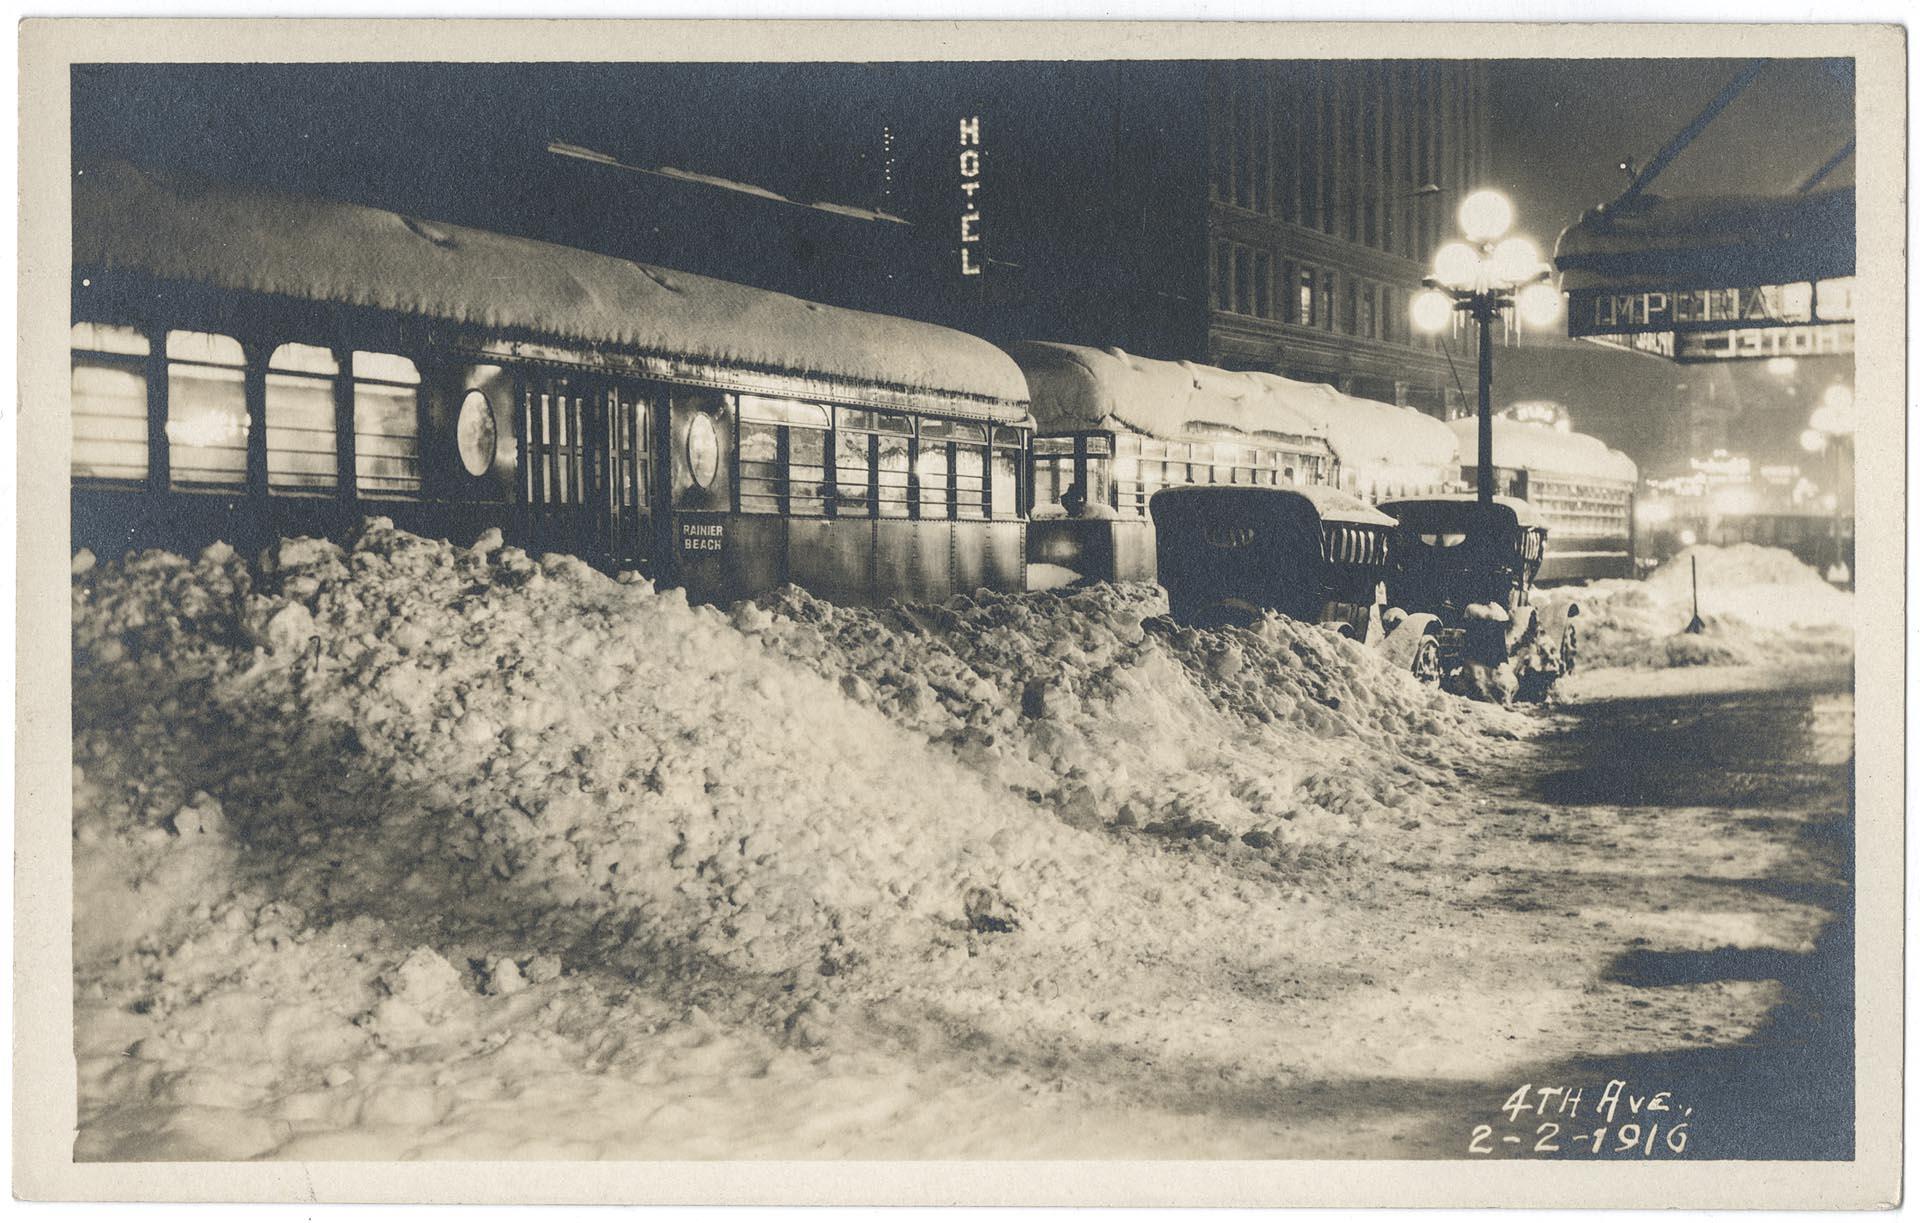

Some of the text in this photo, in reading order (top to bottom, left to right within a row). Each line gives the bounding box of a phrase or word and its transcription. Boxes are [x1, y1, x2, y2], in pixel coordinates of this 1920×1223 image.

[960, 116, 980, 275] HOTEL
[683, 524, 723, 536] RAINIER
[684, 538, 721, 550] BEACH
